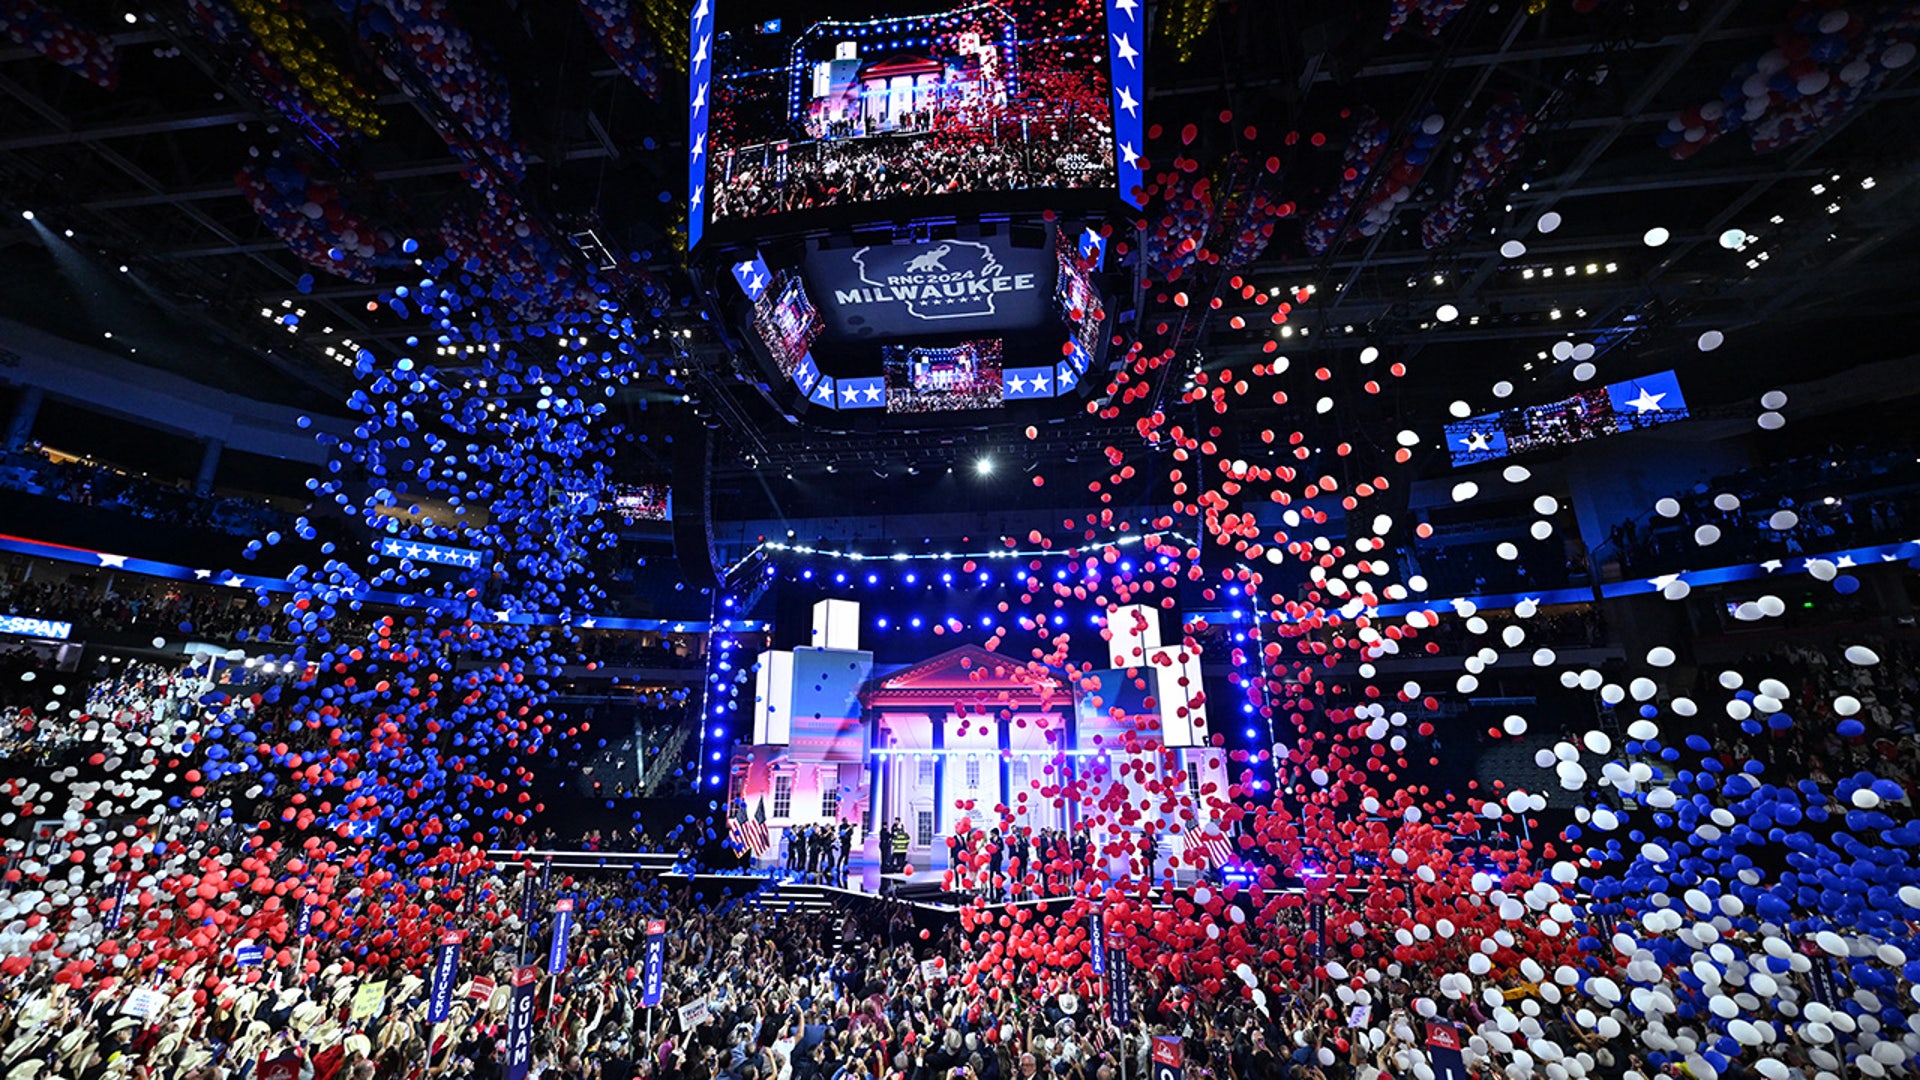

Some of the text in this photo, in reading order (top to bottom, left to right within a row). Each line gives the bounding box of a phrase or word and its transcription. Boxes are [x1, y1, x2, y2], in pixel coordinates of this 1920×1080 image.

[1063, 161, 1093, 170] 2024
[1066, 153, 1089, 161] RNC
[834, 274, 1034, 305] MILWAUKEE
[888, 270, 975, 286] RNC 2024
[299, 888, 315, 931] TXAS
[1093, 915, 1101, 971] FLORIDA
[435, 945, 455, 1018] KENTUCKY
[647, 941, 660, 995] MAINE
[1111, 950, 1119, 1021] INDIANA
[513, 995, 531, 1066] GUAM
